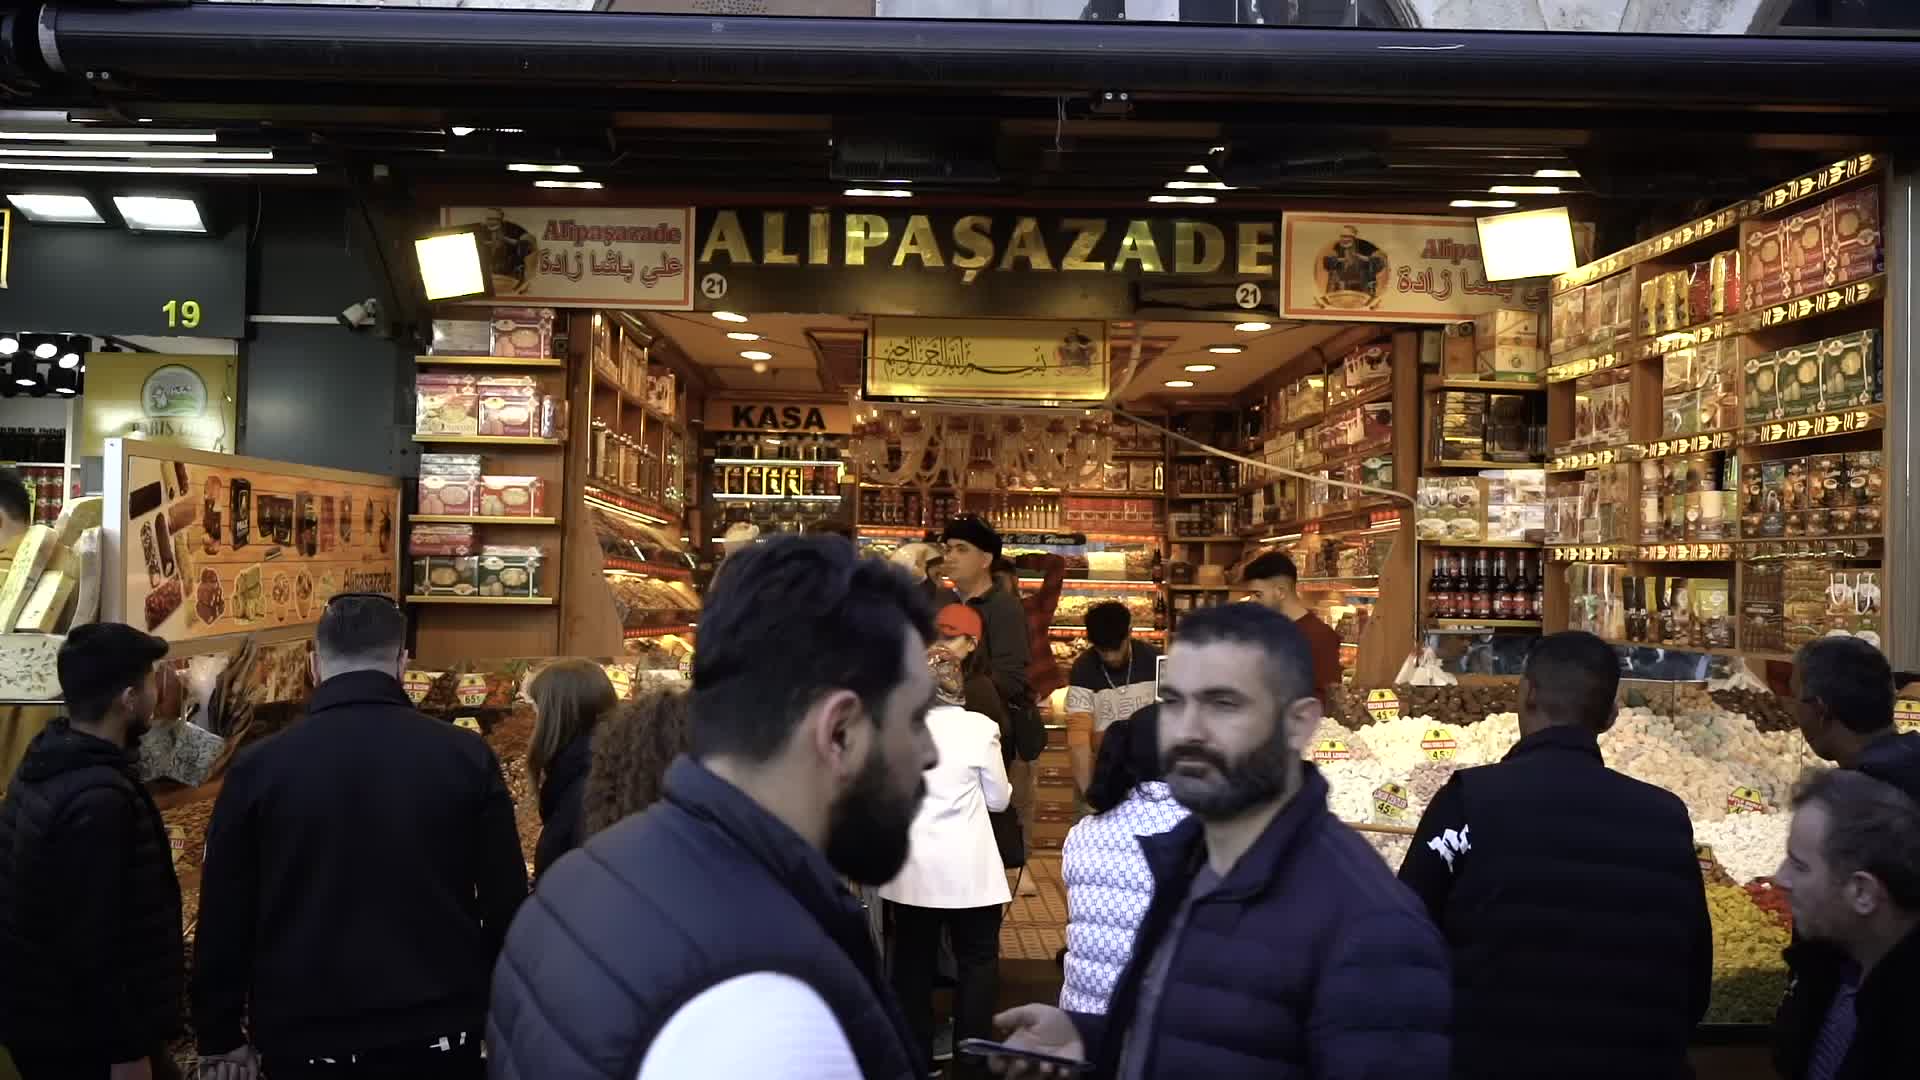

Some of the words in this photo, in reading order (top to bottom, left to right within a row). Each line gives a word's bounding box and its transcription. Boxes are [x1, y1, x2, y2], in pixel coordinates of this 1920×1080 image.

[705, 277, 725, 295] 21
[1239, 287, 1258, 305] 21
[162, 300, 201, 328] 19
[732, 405, 826, 430] KASA
